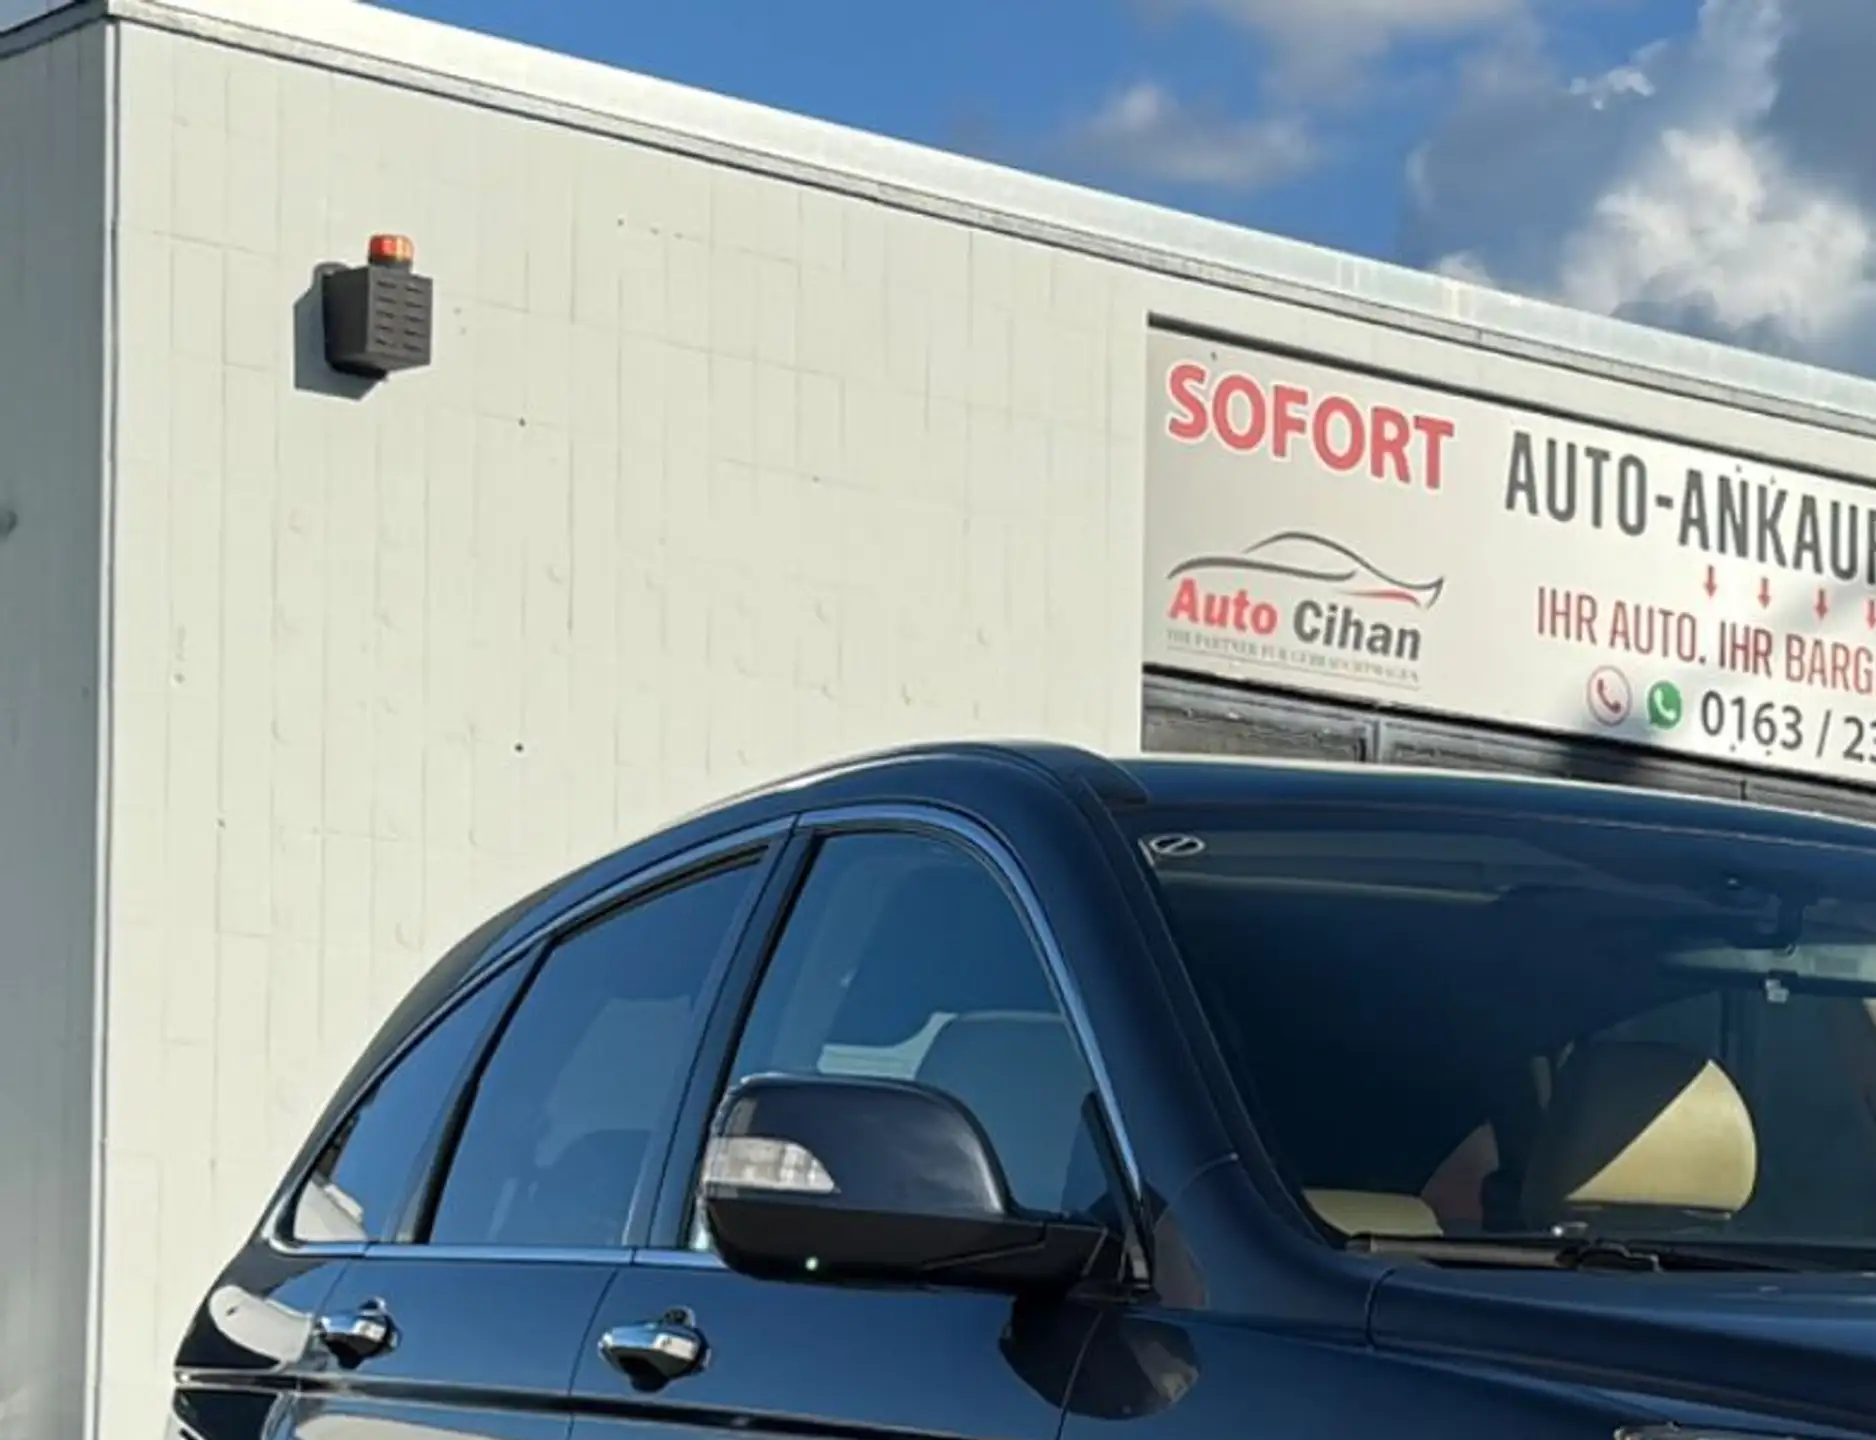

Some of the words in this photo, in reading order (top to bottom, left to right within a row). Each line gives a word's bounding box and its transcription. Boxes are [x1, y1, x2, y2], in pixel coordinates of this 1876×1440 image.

[1168, 364, 1455, 489] SOFORT
[1168, 577, 1278, 635] Auto
[1293, 599, 1421, 661] Cihan
[1538, 586, 1597, 645] IHR
[1609, 599, 1706, 665] AUTO.
[1719, 620, 1773, 678] IHR
[1701, 690, 1804, 750] 0163
[1816, 709, 1832, 758] /
